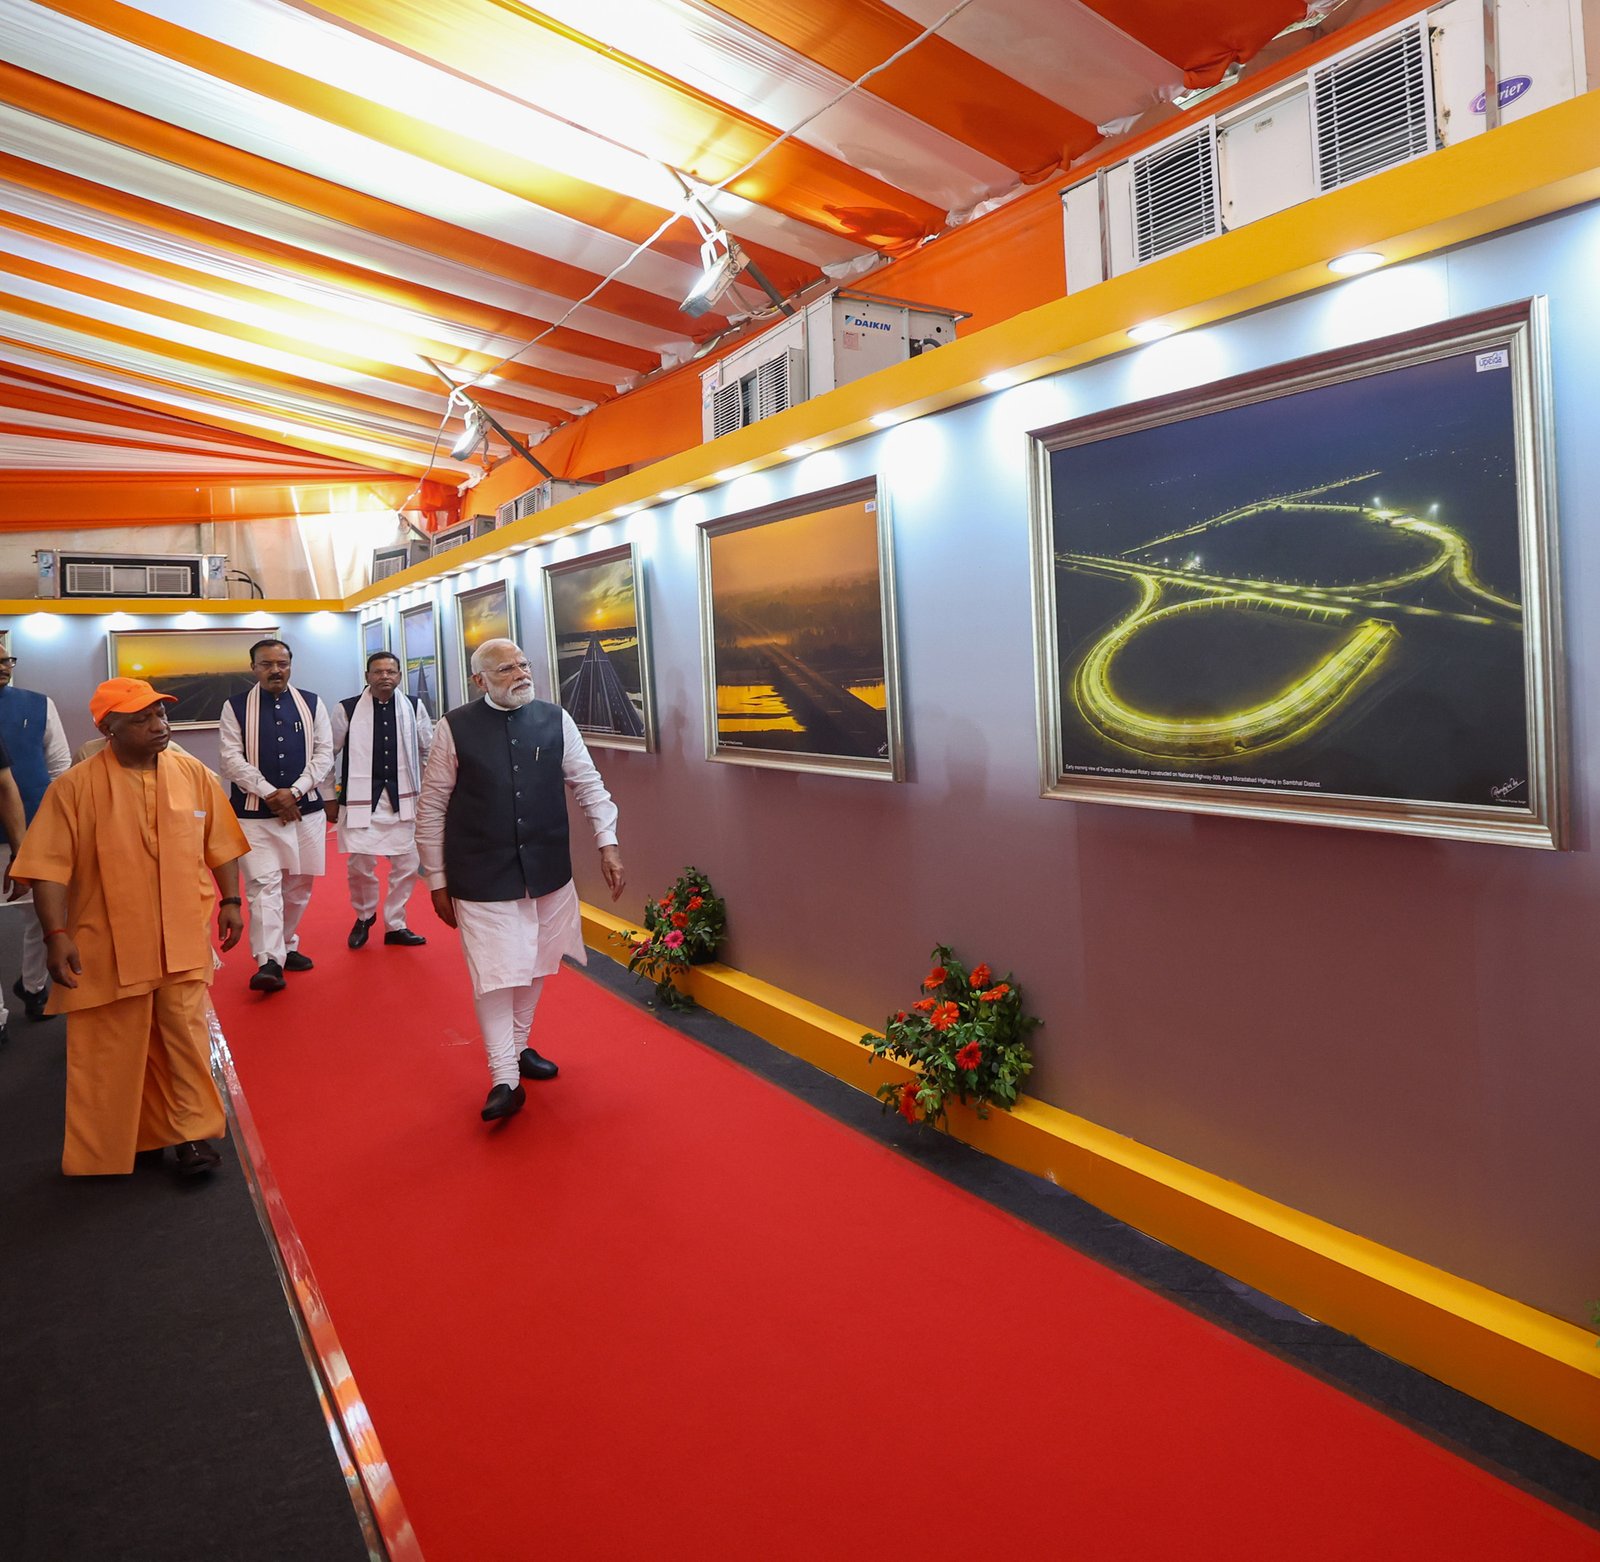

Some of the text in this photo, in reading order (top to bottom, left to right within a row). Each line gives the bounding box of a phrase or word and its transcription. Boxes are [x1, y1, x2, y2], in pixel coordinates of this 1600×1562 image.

[1476, 82, 1523, 111] Crier
[854, 318, 892, 332] DAIKIN
[1065, 763, 1074, 771] Early
[1232, 775, 1257, 783] Moradabad
